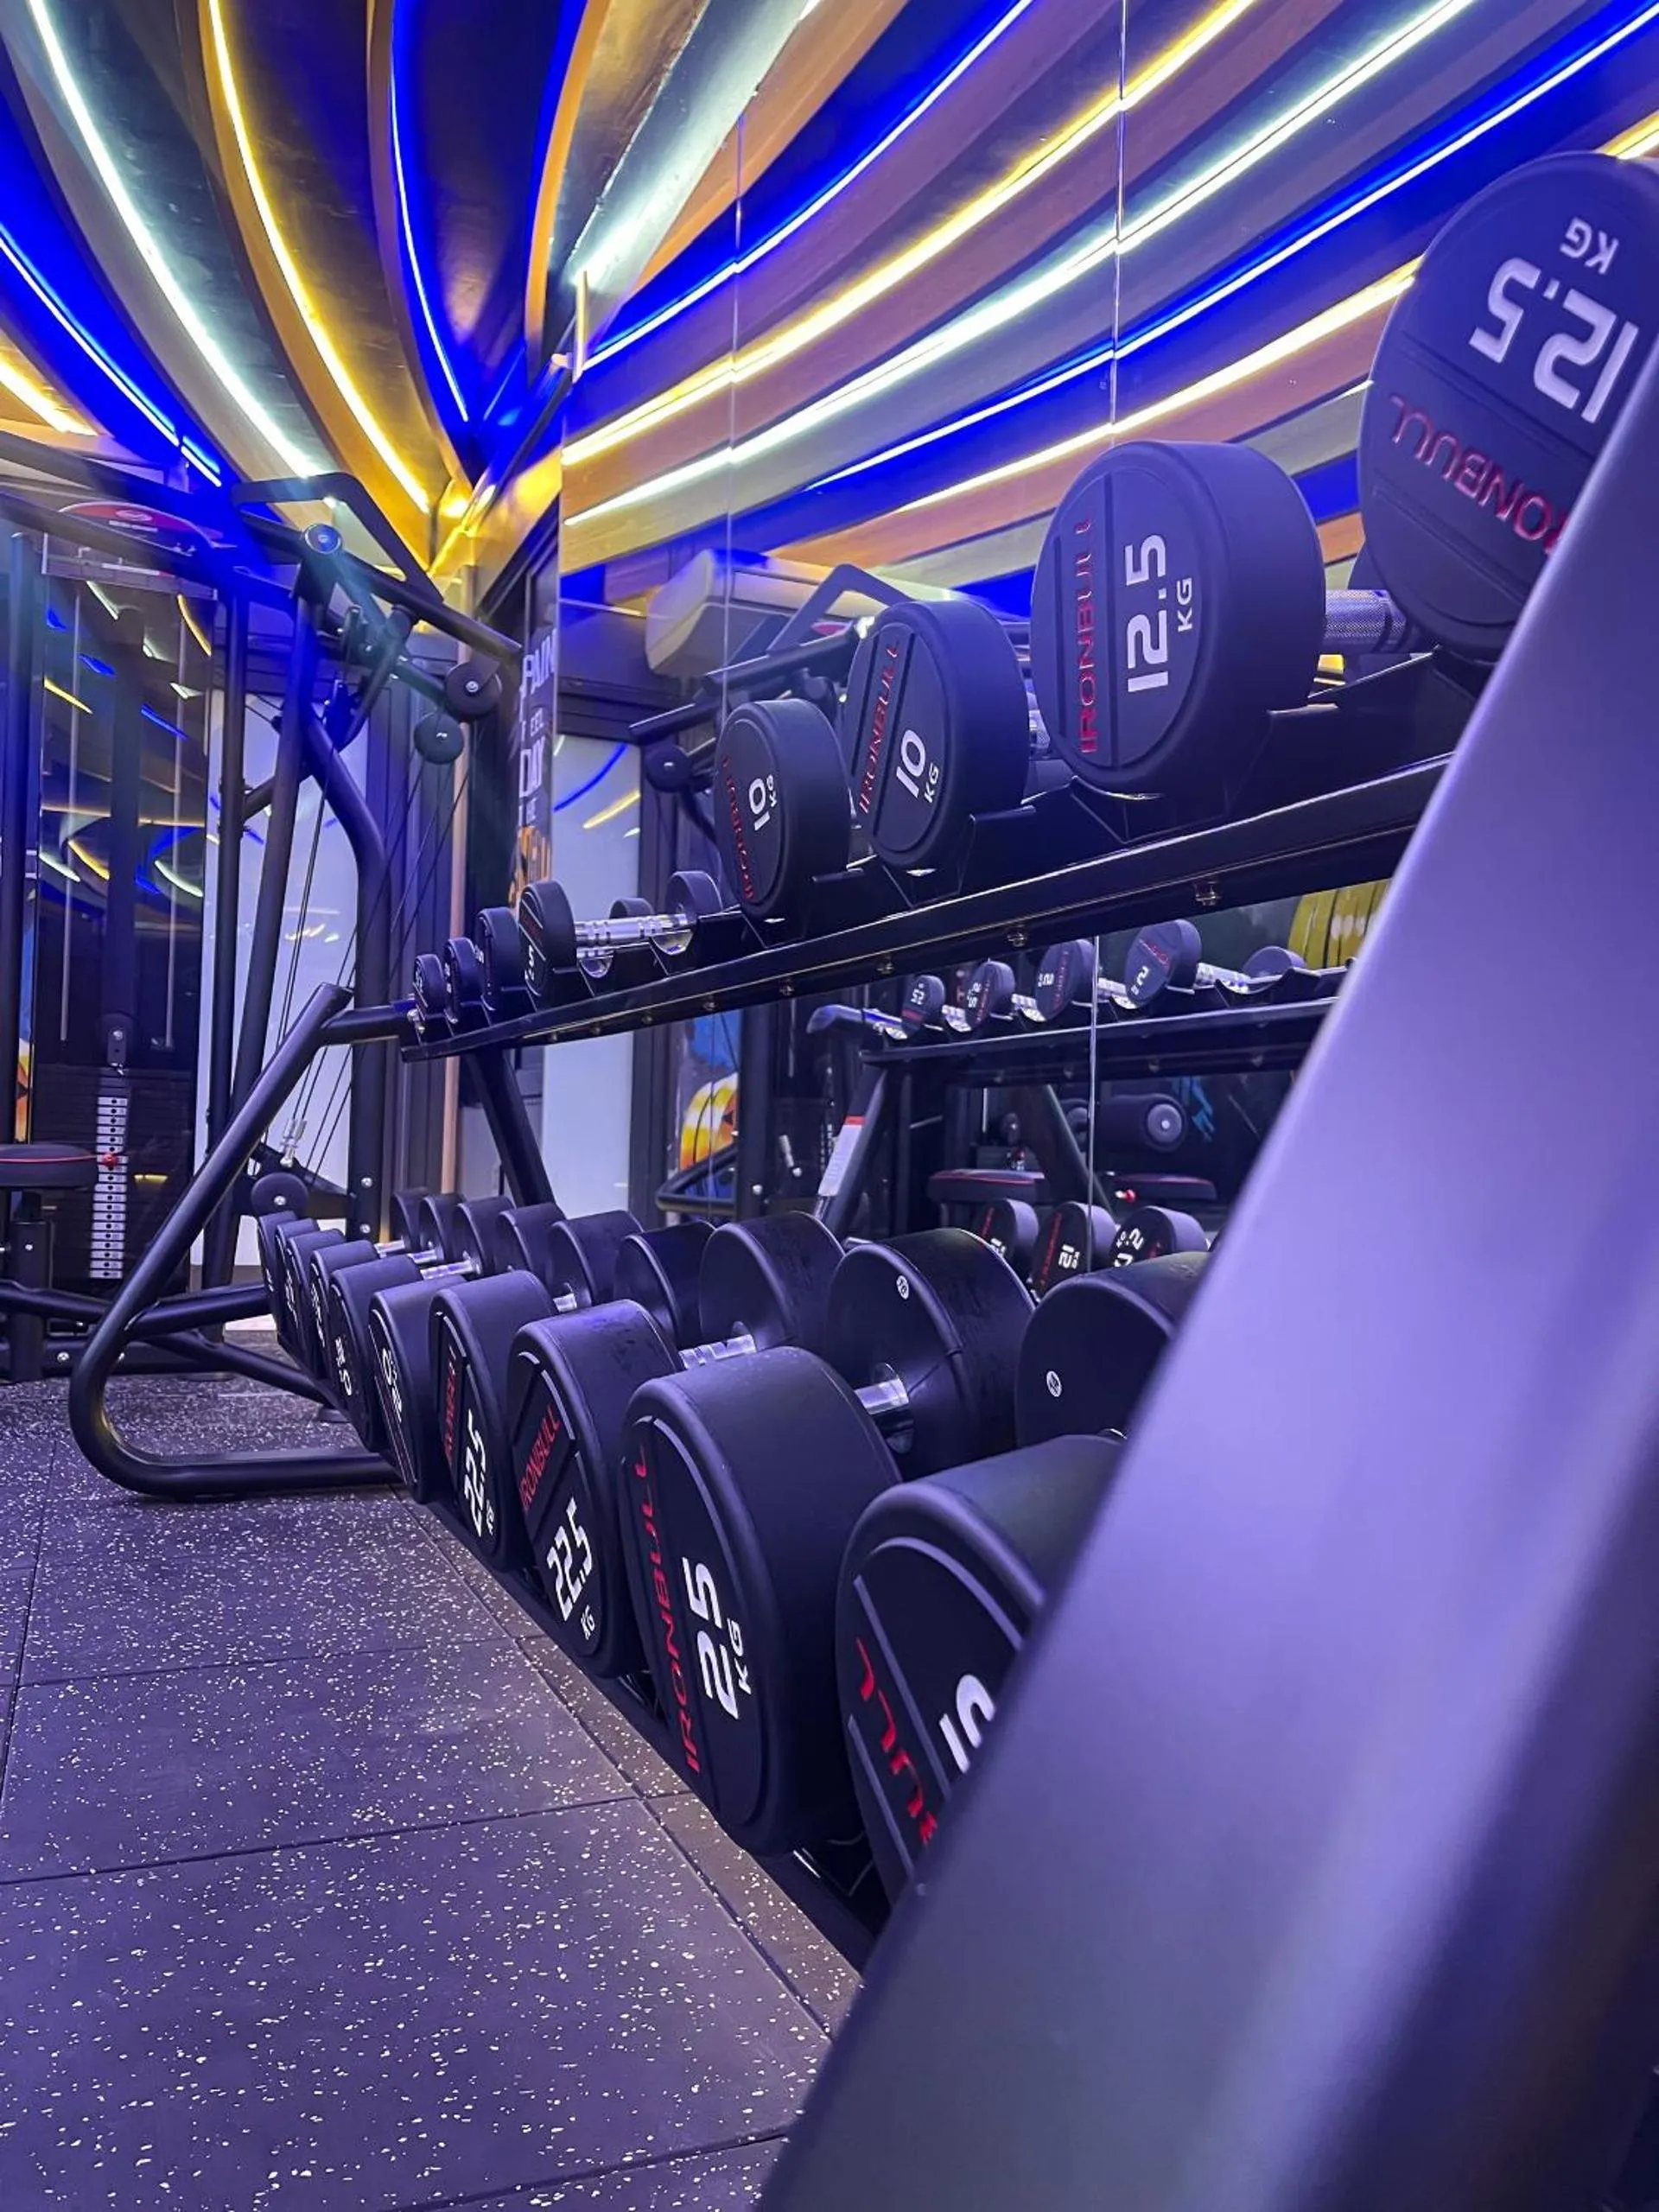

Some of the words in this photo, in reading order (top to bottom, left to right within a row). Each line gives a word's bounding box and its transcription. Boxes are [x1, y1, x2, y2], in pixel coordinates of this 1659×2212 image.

[1560, 218, 1619, 275] KG
[1469, 257, 1639, 423] 12.5
[1125, 534, 1169, 692] 12.5
[1177, 577, 1193, 632] KG
[767, 774, 778, 808] KG
[896, 729, 925, 798] 10
[924, 762, 939, 803] KG
[748, 778, 770, 831] 10
[546, 1497, 593, 1622] 22.5
[581, 1605, 596, 1640] KG
[634, 1444, 701, 1774] IRONBULL
[682, 1556, 740, 1719] 25
[728, 1618, 752, 1694] KG
